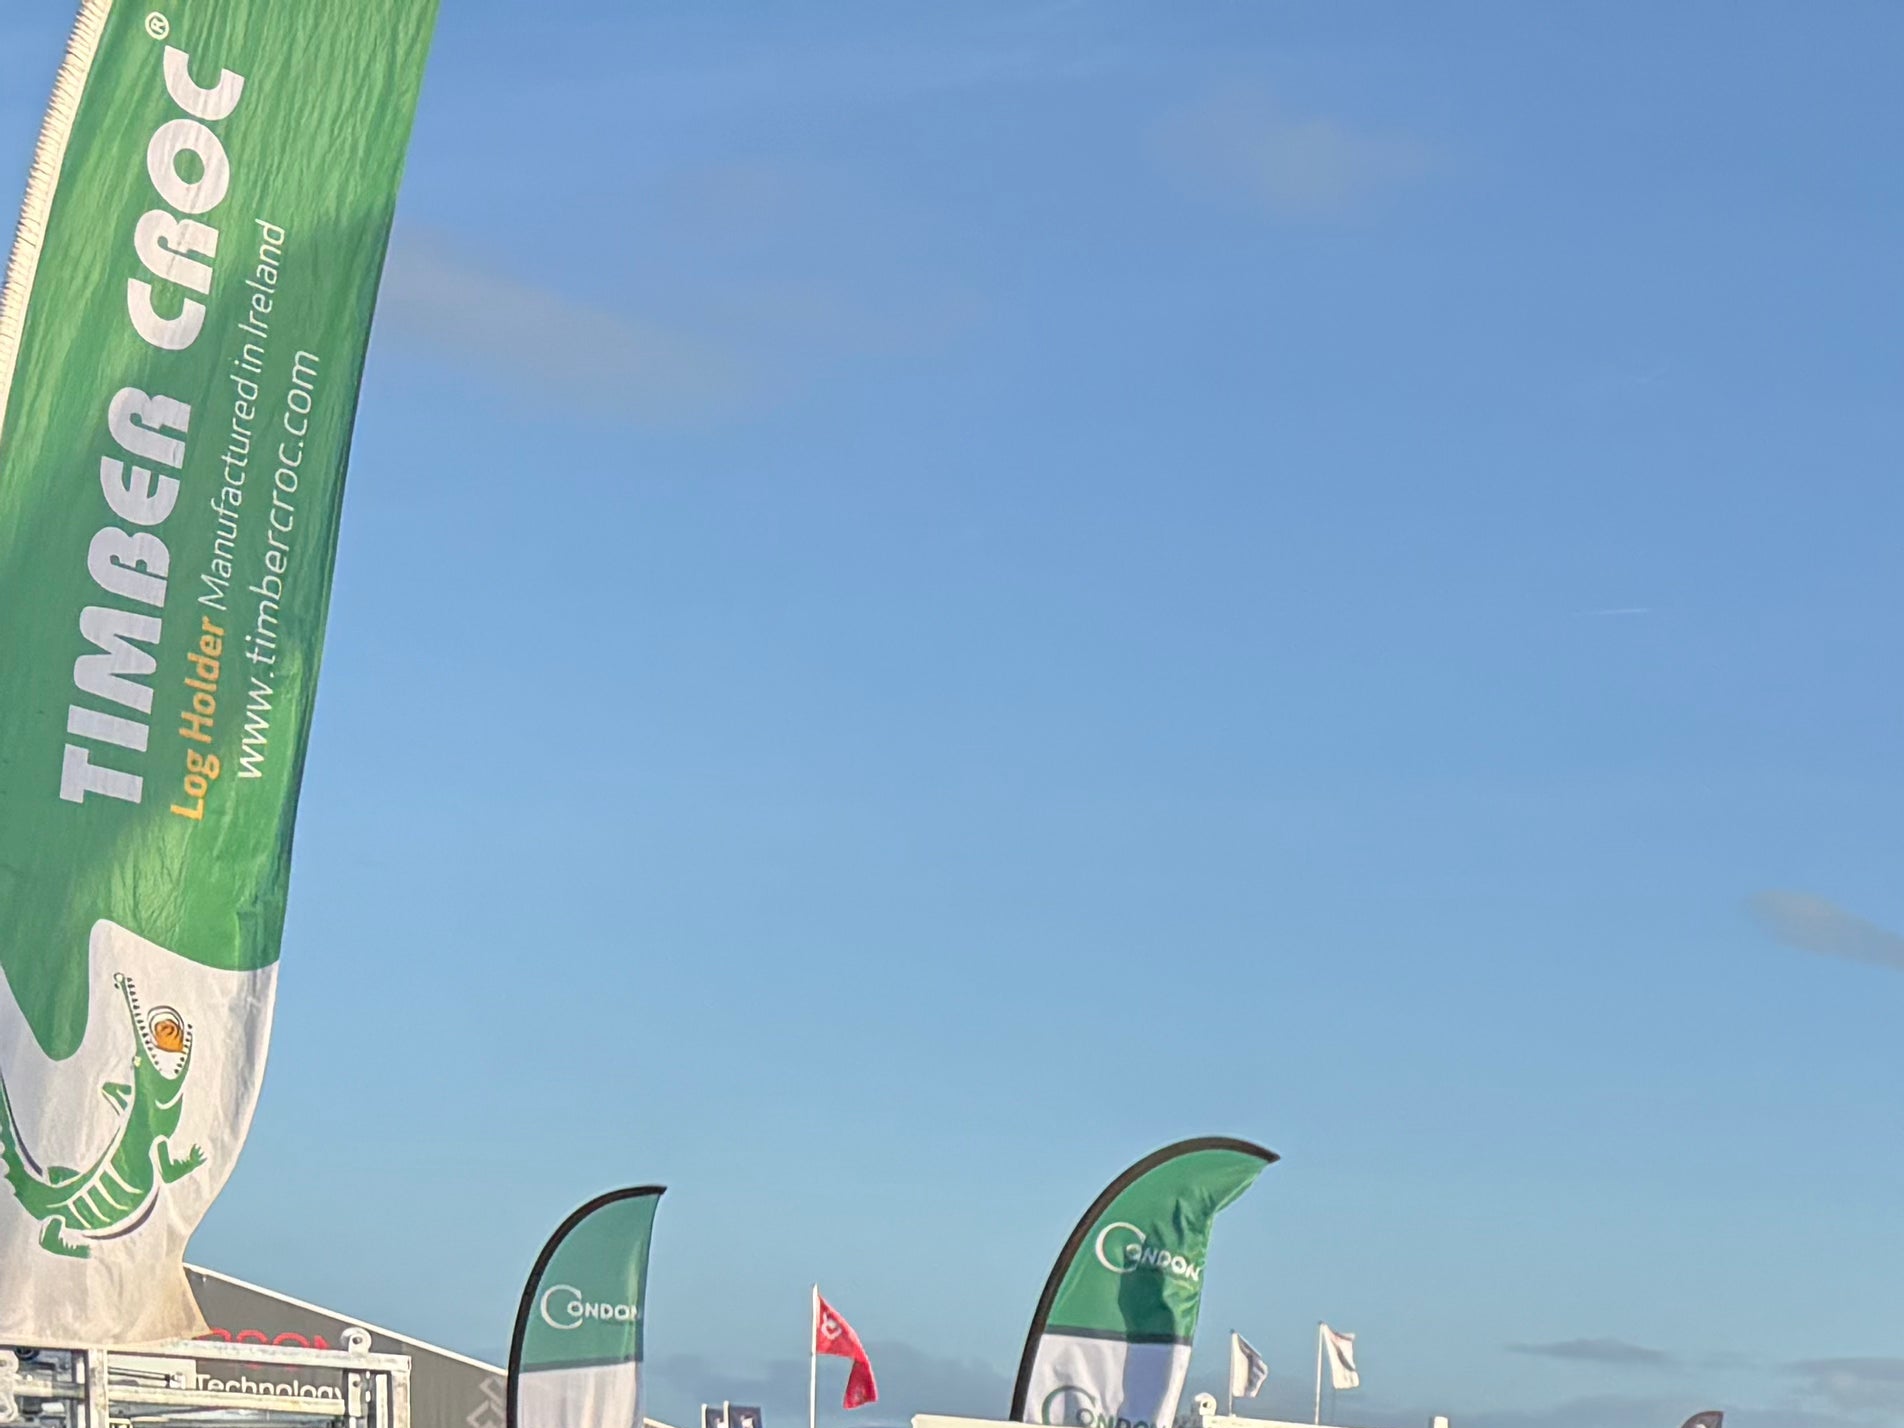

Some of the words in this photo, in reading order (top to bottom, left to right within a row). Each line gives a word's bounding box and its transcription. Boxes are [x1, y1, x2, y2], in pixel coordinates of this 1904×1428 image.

[238, 218, 287, 339] Ireland
[229, 340, 265, 375] in
[60, 387, 191, 804] TIMBER
[127, 45, 245, 351] CROC
[198, 374, 259, 611] Manufactured
[238, 349, 320, 780] www.timbercroc.com
[179, 616, 228, 744] Holder
[170, 748, 220, 821] Log
[1096, 1221, 1201, 1283] CONDON
